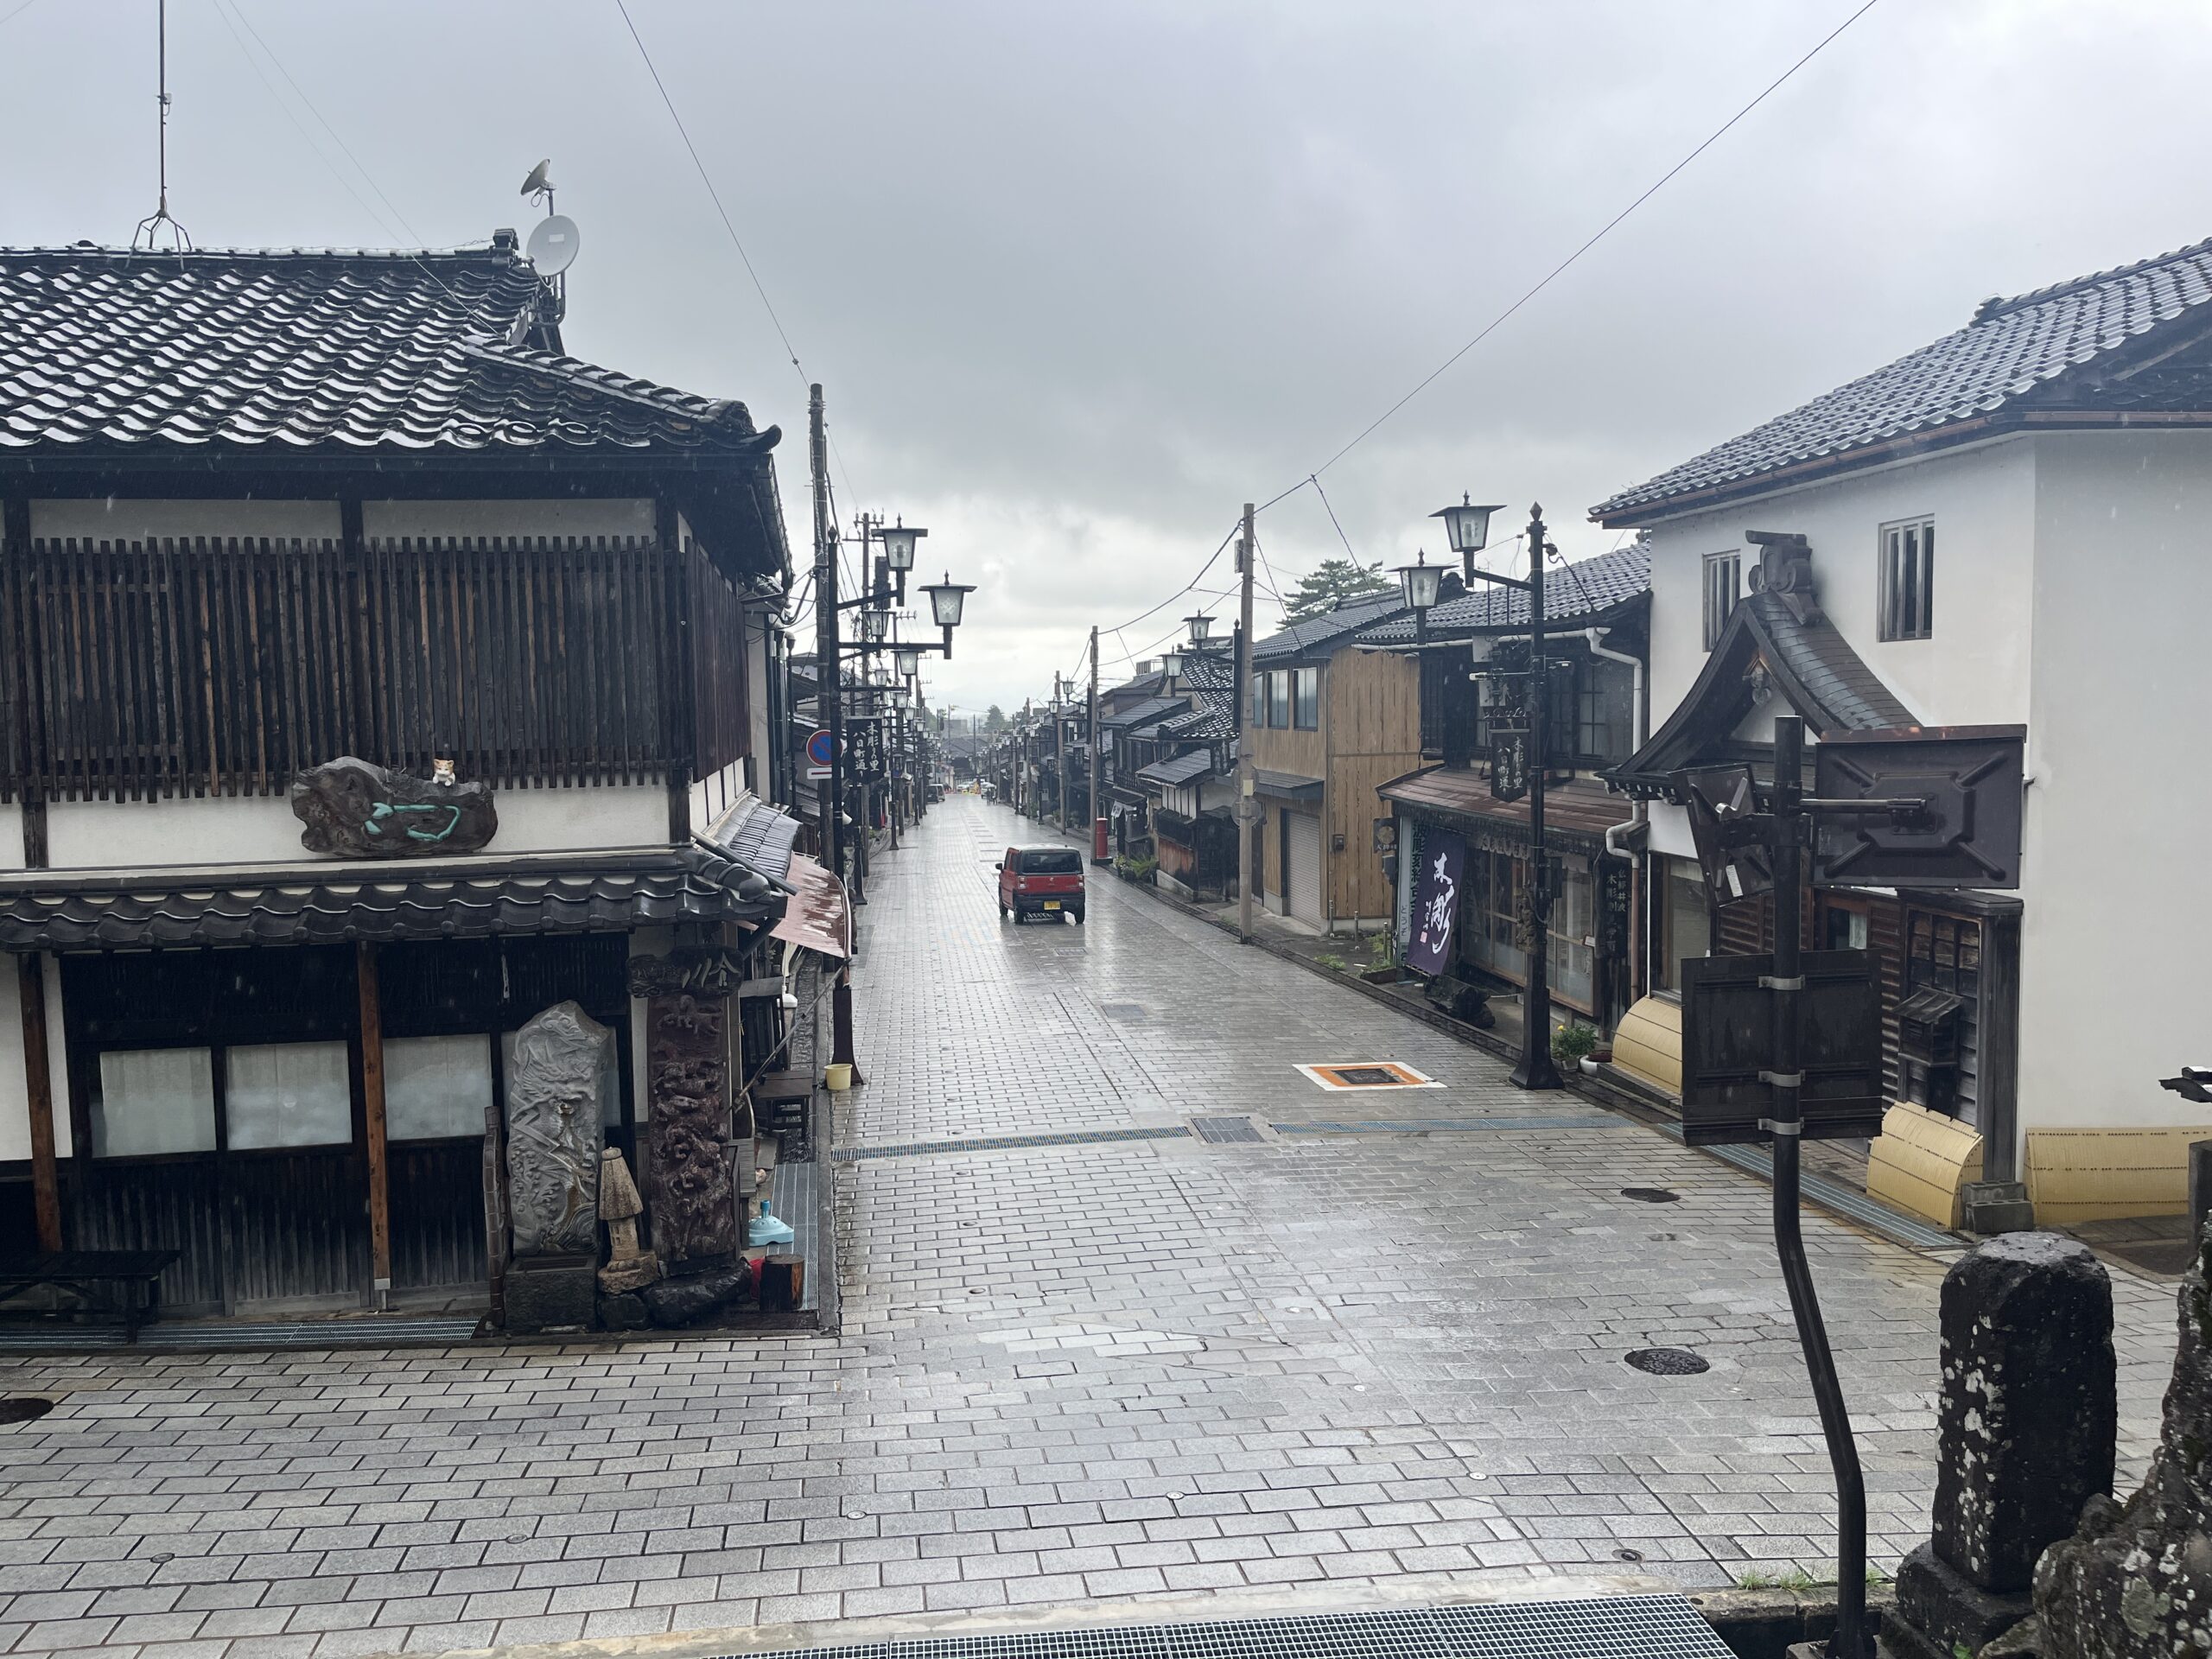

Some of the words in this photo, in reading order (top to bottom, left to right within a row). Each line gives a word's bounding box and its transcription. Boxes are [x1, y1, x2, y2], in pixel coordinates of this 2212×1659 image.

[853, 731, 868, 778] 八日町通り
[867, 721, 880, 772] 木彫りの里
